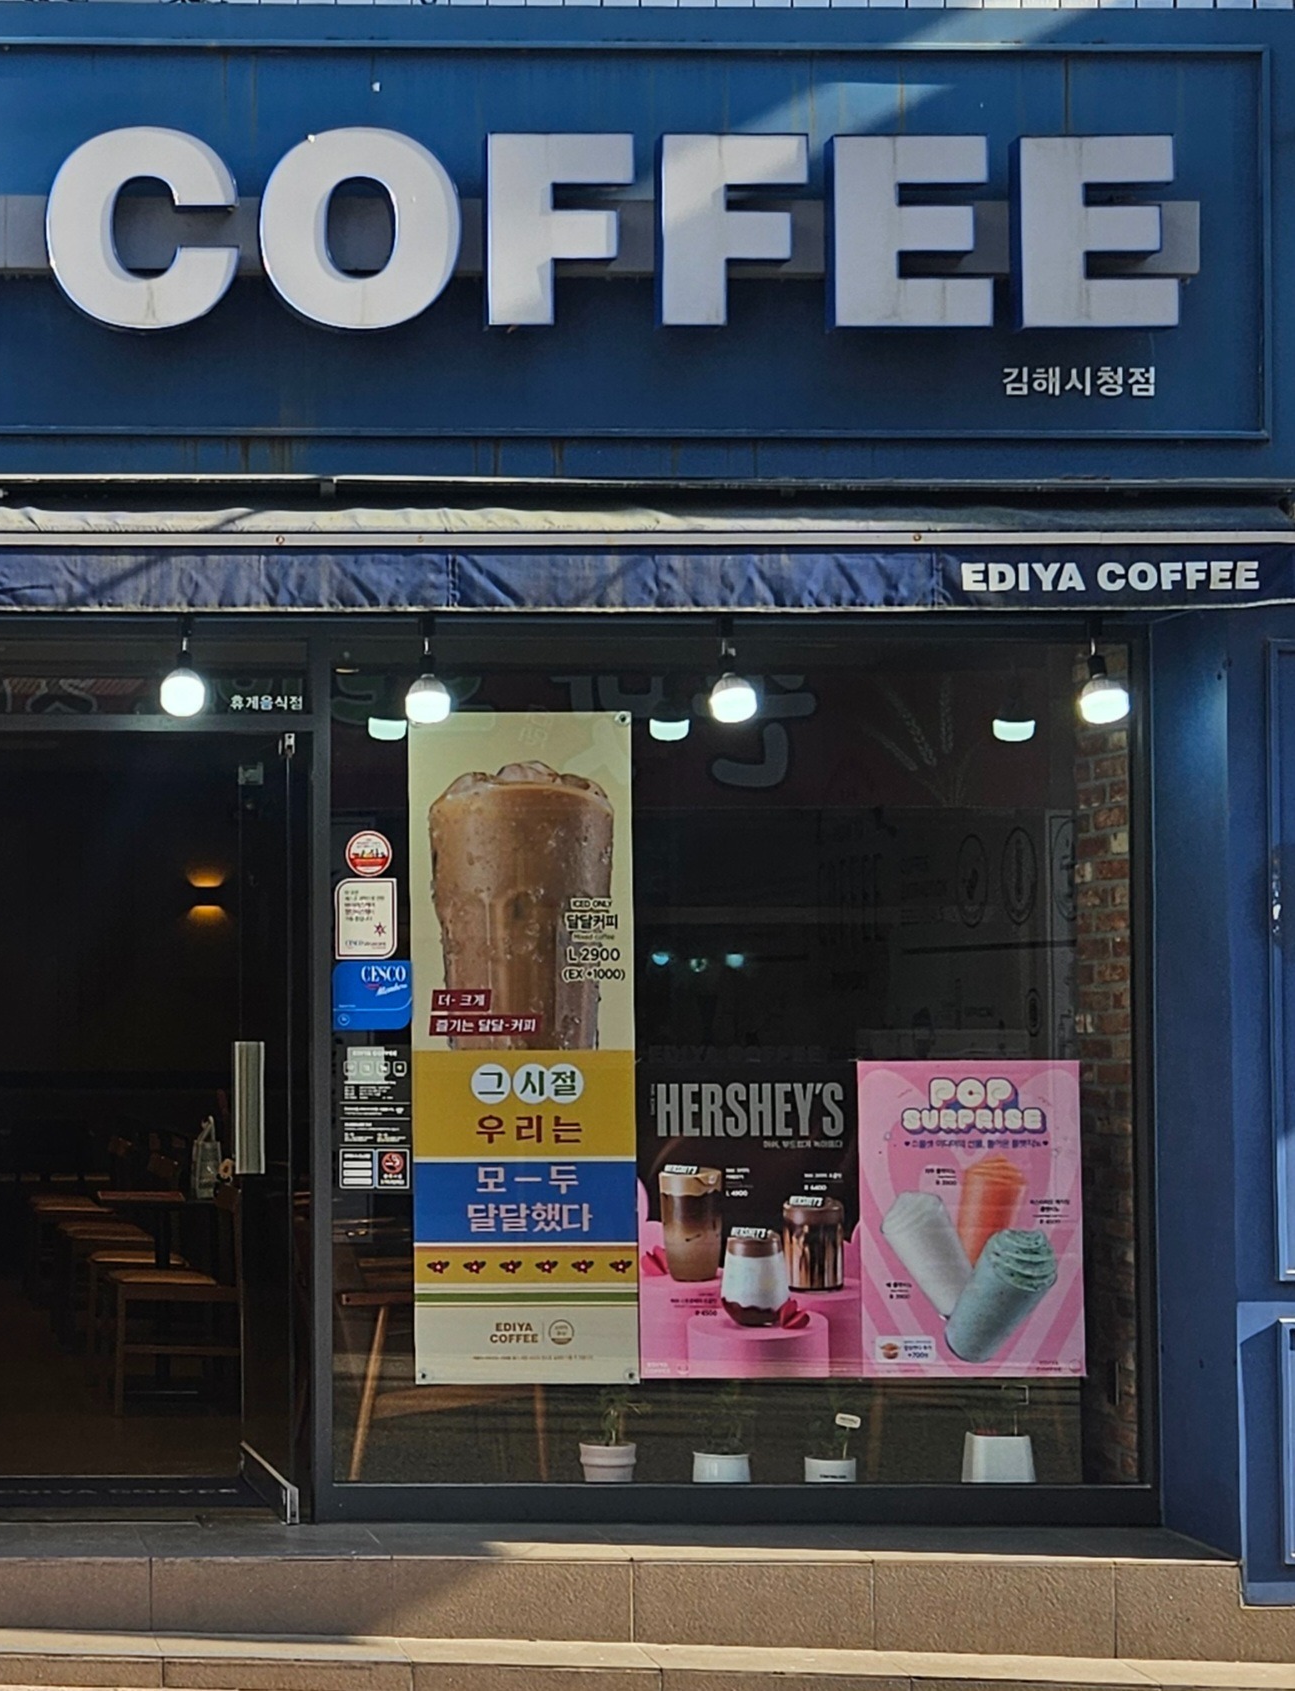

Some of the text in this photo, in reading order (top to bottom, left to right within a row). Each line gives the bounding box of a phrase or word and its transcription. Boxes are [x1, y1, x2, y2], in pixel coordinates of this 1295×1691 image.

[45, 126, 1180, 330] COFFEE
[1001, 365, 1157, 398] 김해시청점
[961, 560, 1260, 592] EDIYA COFFEE
[230, 694, 304, 712] 휴게음식점
[572, 900, 612, 908] ICED ONLY
[566, 913, 618, 930] 달달커피
[568, 947, 620, 962] L 2900
[361, 965, 407, 982] CESCO
[564, 968, 584, 981] (EX
[459, 994, 485, 1007] 크게
[436, 1018, 474, 1032] 즐기는
[929, 1077, 1016, 1109] POP
[656, 1082, 844, 1137] HERSHEY'S
[475, 1114, 583, 1145] 우리는
[902, 1108, 1045, 1134] SURPRISE
[466, 1202, 592, 1233] 달달했다
[495, 1322, 533, 1332] EDIYA
[489, 1333, 539, 1344] COFFEE
